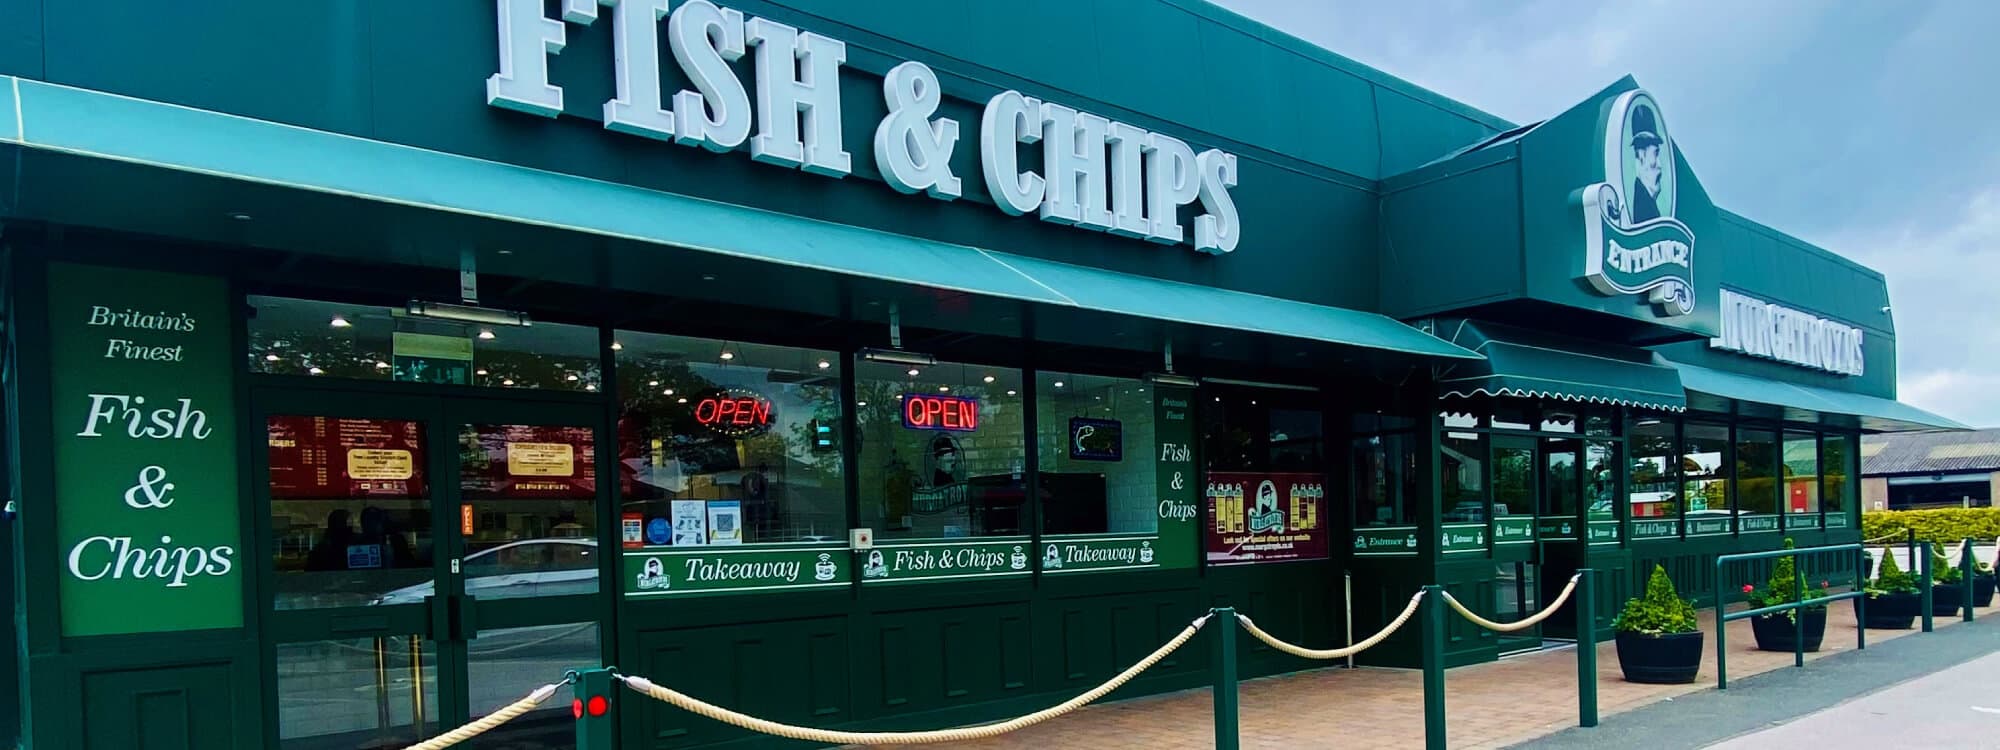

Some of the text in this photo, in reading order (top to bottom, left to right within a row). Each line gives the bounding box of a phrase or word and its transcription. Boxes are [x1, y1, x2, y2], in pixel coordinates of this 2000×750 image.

[486, 0, 1239, 254] FISH & CHIPS
[1607, 238, 1688, 273] ENTRANCE
[88, 305, 195, 332] Britain's
[104, 338, 183, 362] Finest
[76, 394, 212, 439] Fish
[695, 397, 772, 425] OPEN
[907, 397, 976, 430] OPEN
[1160, 443, 1191, 462] Fish
[124, 465, 175, 509] &
[1171, 471, 1184, 490] &
[1158, 499, 1197, 521] Chips
[67, 536, 234, 587] Chips
[893, 549, 1005, 571] Fish & Chips
[1065, 545, 1136, 563] Takeaway
[685, 559, 800, 582] Takeaway
